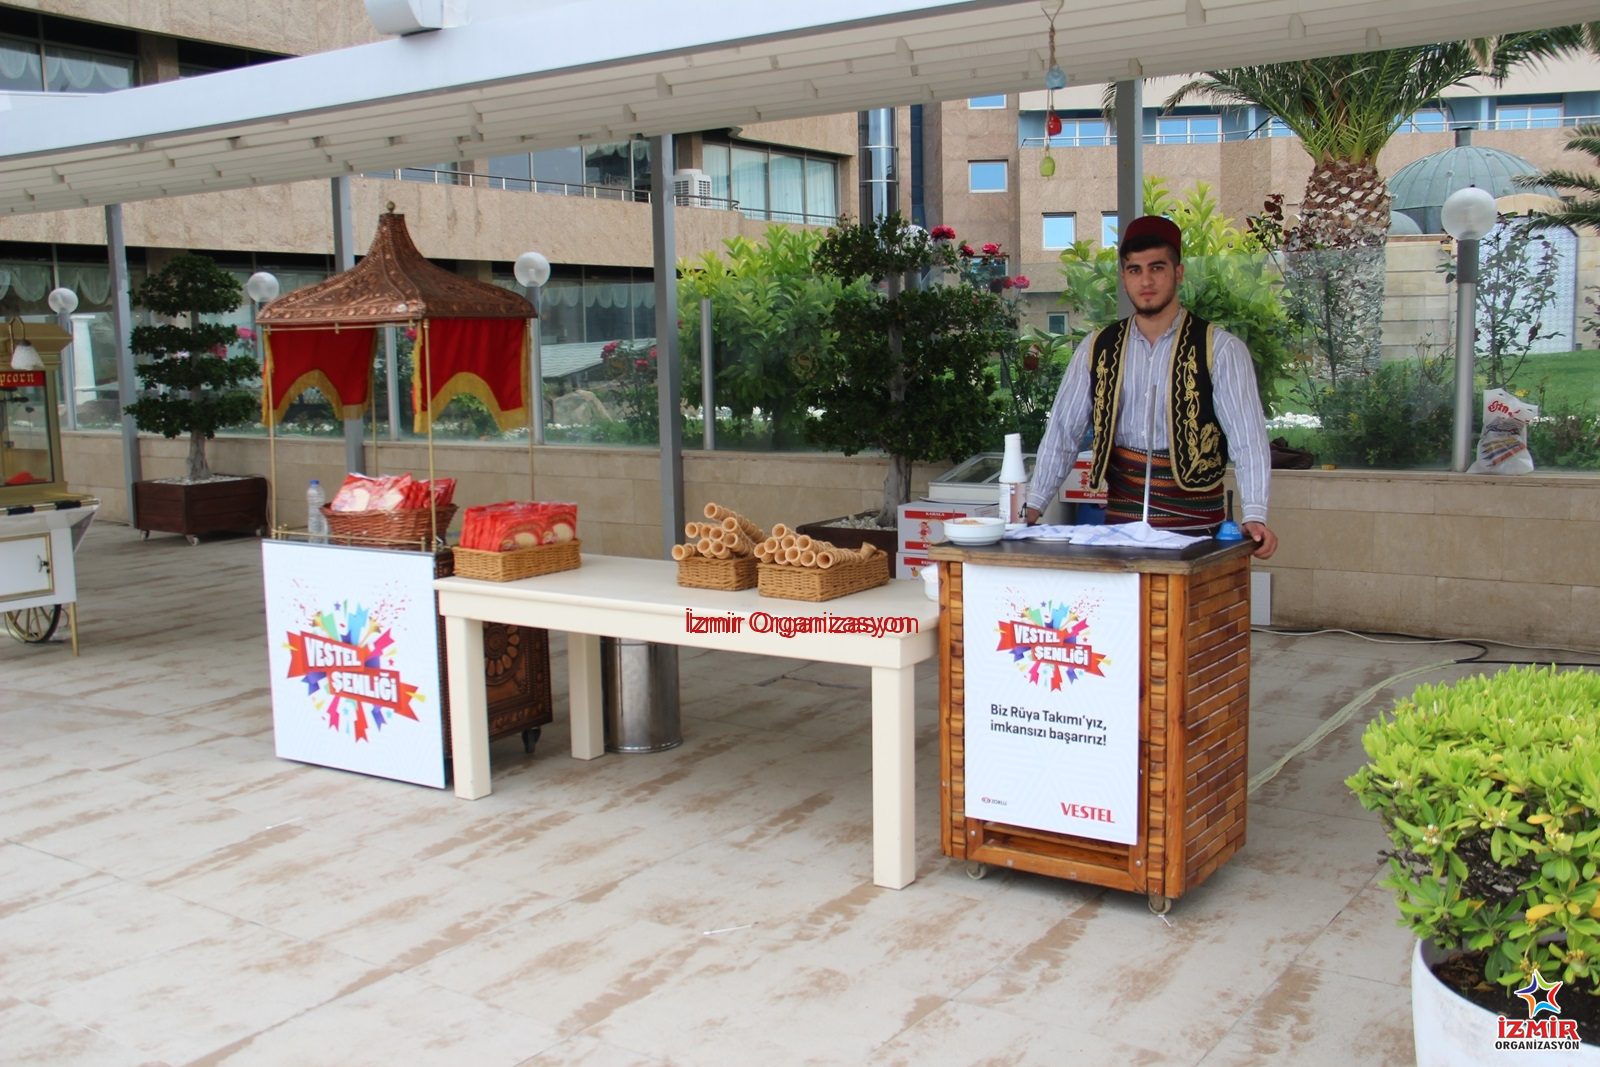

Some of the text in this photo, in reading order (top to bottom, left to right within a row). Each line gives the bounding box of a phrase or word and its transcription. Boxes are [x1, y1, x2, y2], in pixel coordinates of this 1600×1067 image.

[1013, 624, 1060, 644] VESTEL
[304, 636, 361, 667] VESTEL
[990, 703, 1107, 731] Biz Rüya Takımı'yız,
[990, 720, 1107, 746] imkansızı başarırız!
[1060, 802, 1115, 824] VESTEL
